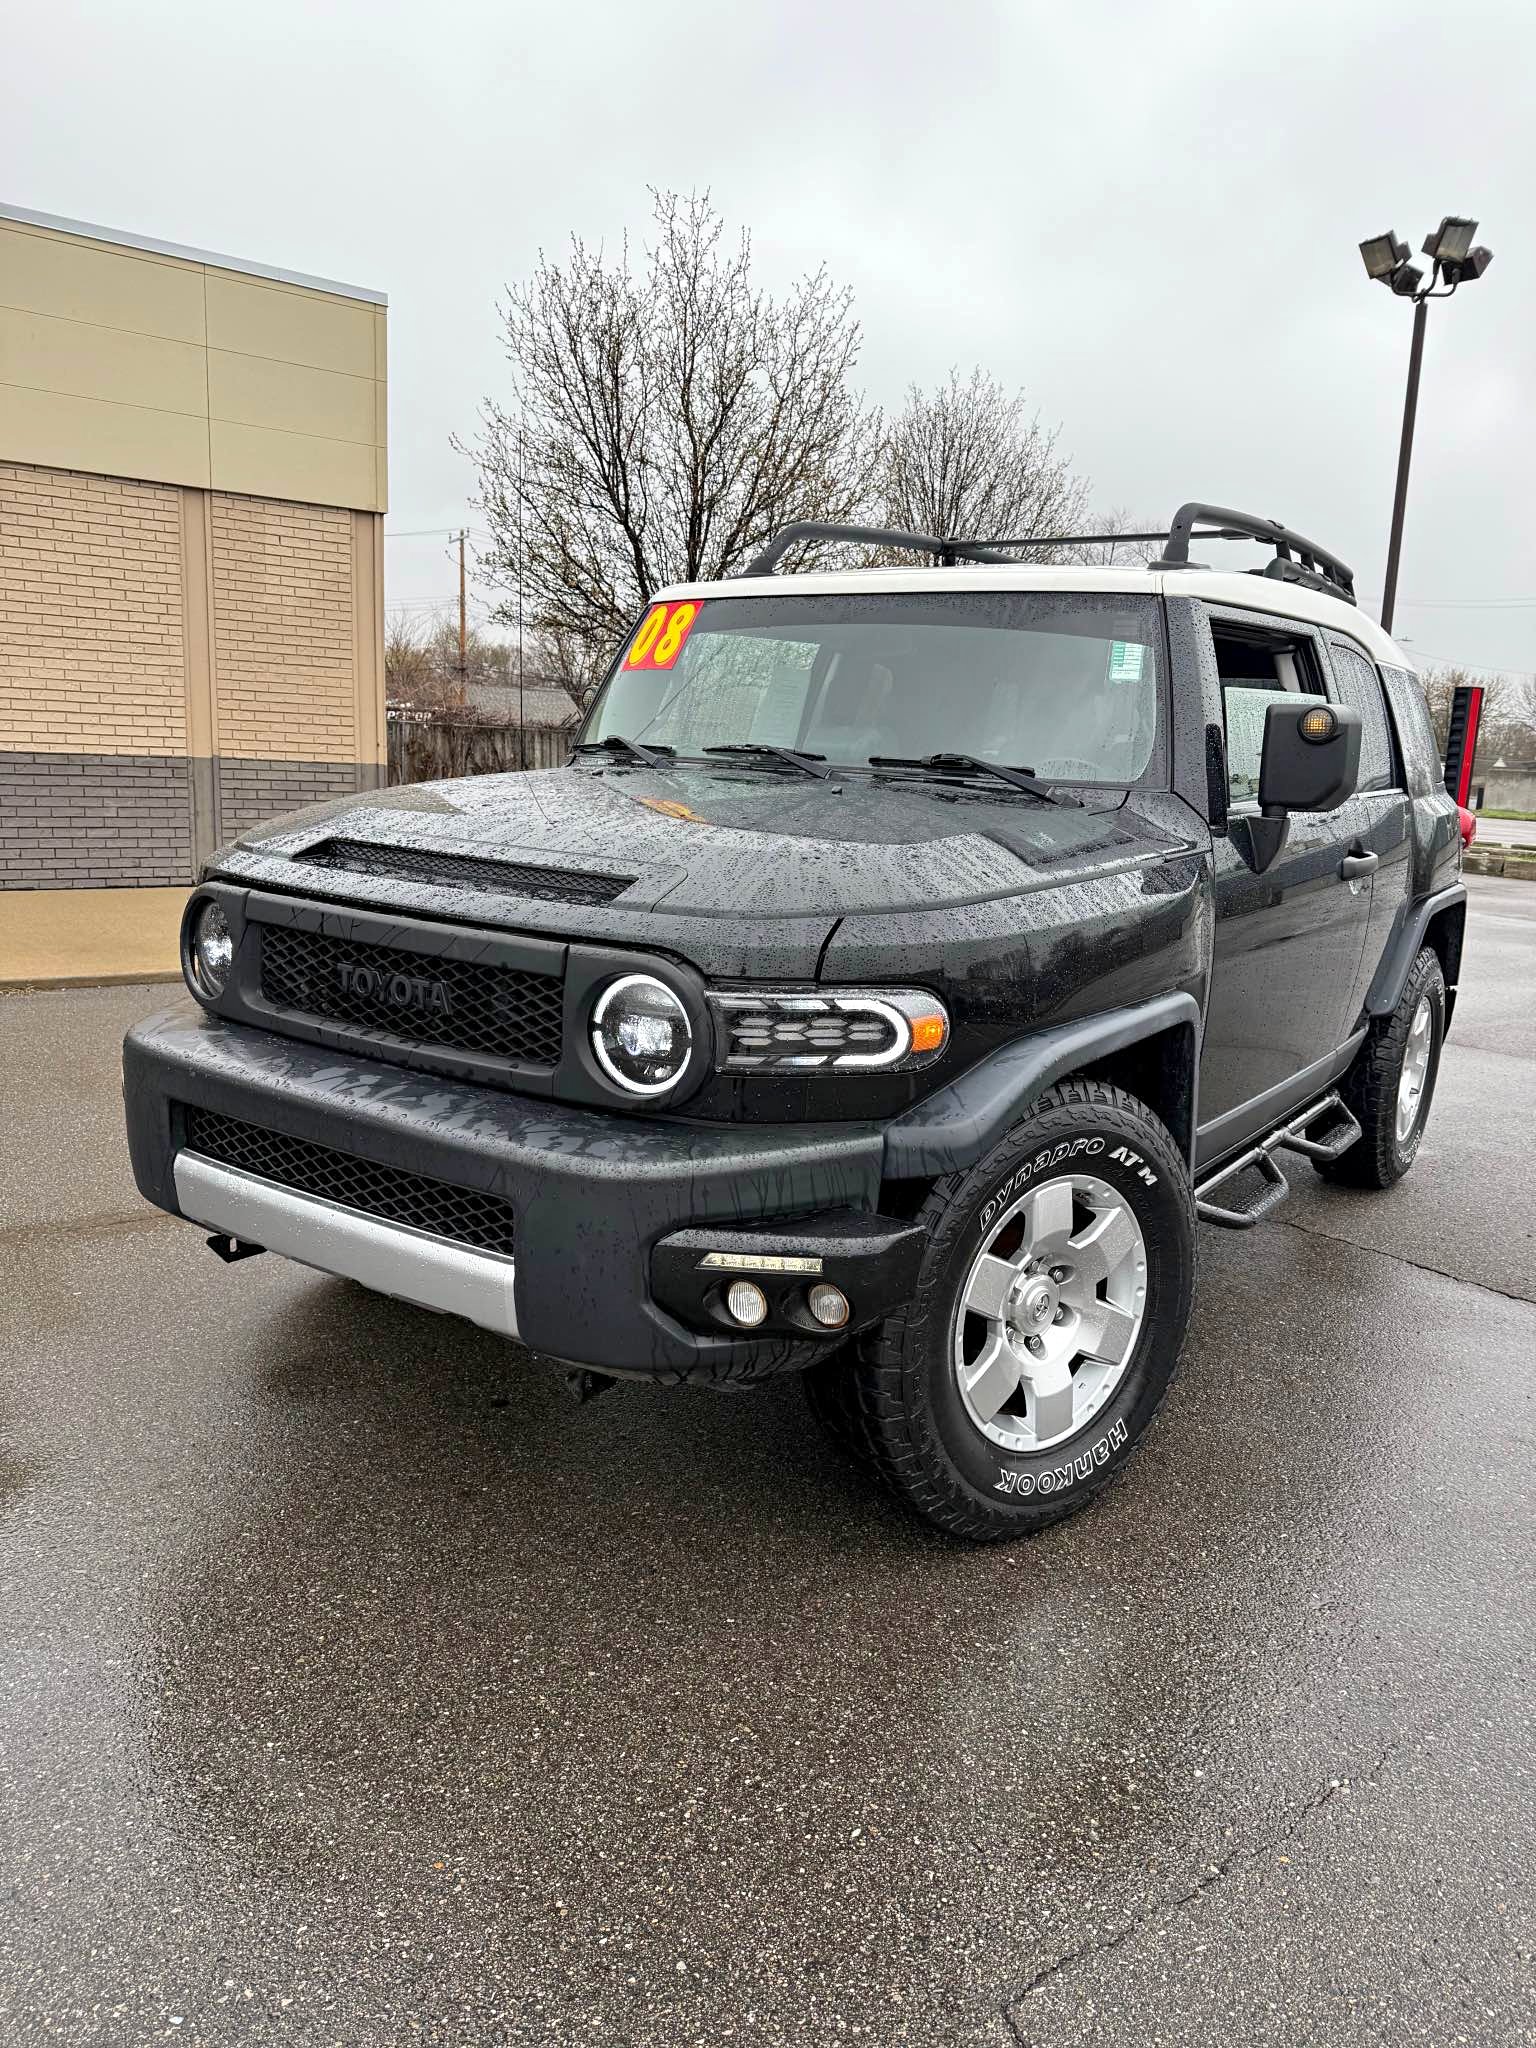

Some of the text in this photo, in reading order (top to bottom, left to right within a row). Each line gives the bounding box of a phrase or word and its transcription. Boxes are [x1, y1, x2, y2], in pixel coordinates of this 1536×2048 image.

[628, 603, 695, 666] 08
[337, 961, 452, 1016] TOYOTA
[979, 1136, 1106, 1232] Dynapro
